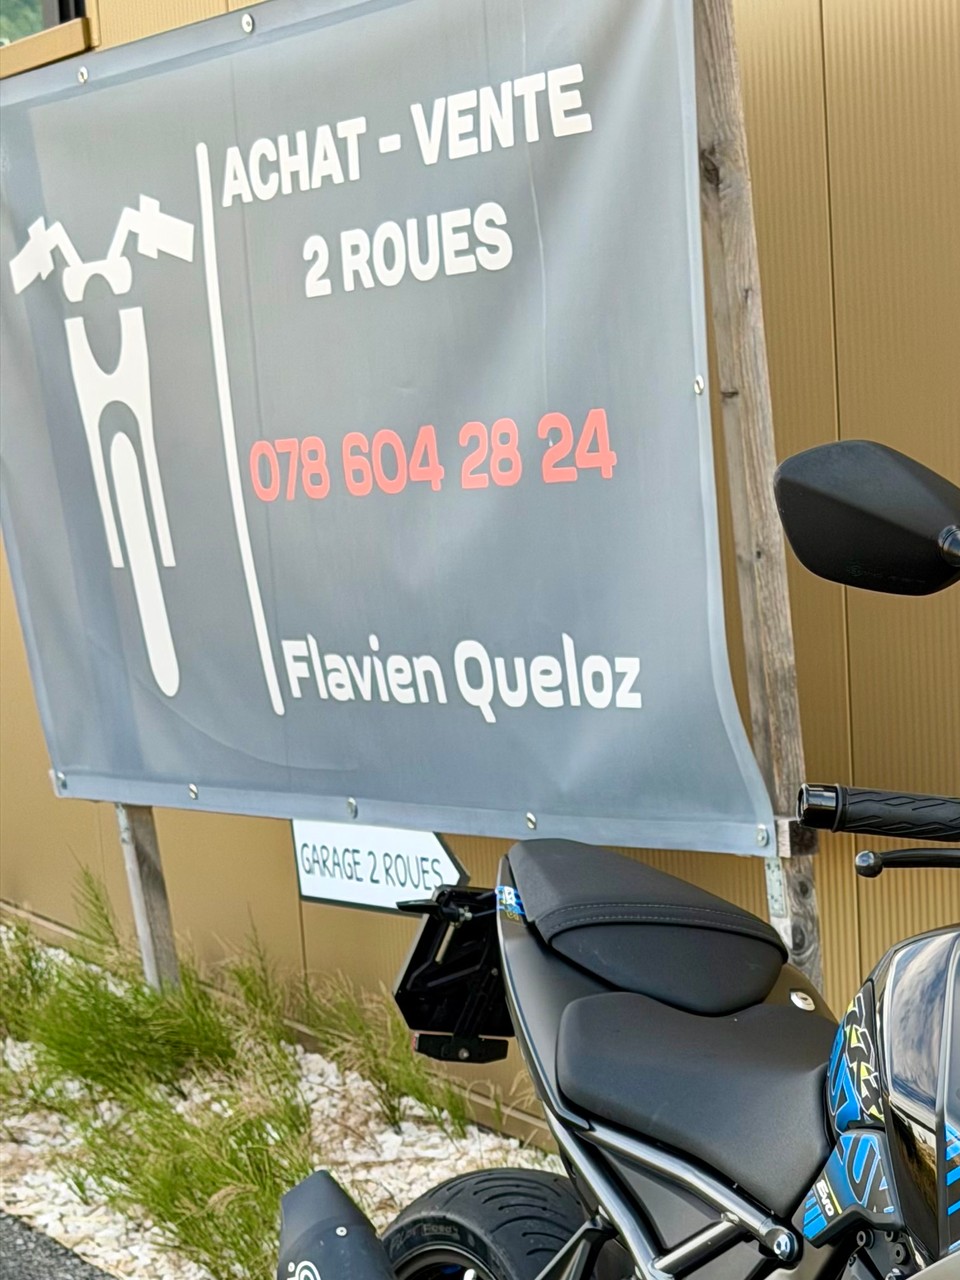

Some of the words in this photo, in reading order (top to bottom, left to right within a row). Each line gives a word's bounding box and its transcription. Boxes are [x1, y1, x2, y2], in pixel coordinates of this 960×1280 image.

[222, 116, 366, 207] ACHAT
[379, 134, 401, 153] -
[410, 63, 592, 166] VENTE
[303, 235, 332, 298] 2
[340, 202, 513, 292] ROUES
[250, 436, 330, 501] 078
[342, 425, 444, 494] 604
[459, 418, 522, 488] 28
[538, 408, 617, 483] 24
[281, 633, 447, 704] Flavien
[454, 632, 642, 723] Queloz
[301, 843, 363, 881] GARAGE
[368, 851, 380, 884] 2
[384, 853, 444, 890] ROUES
